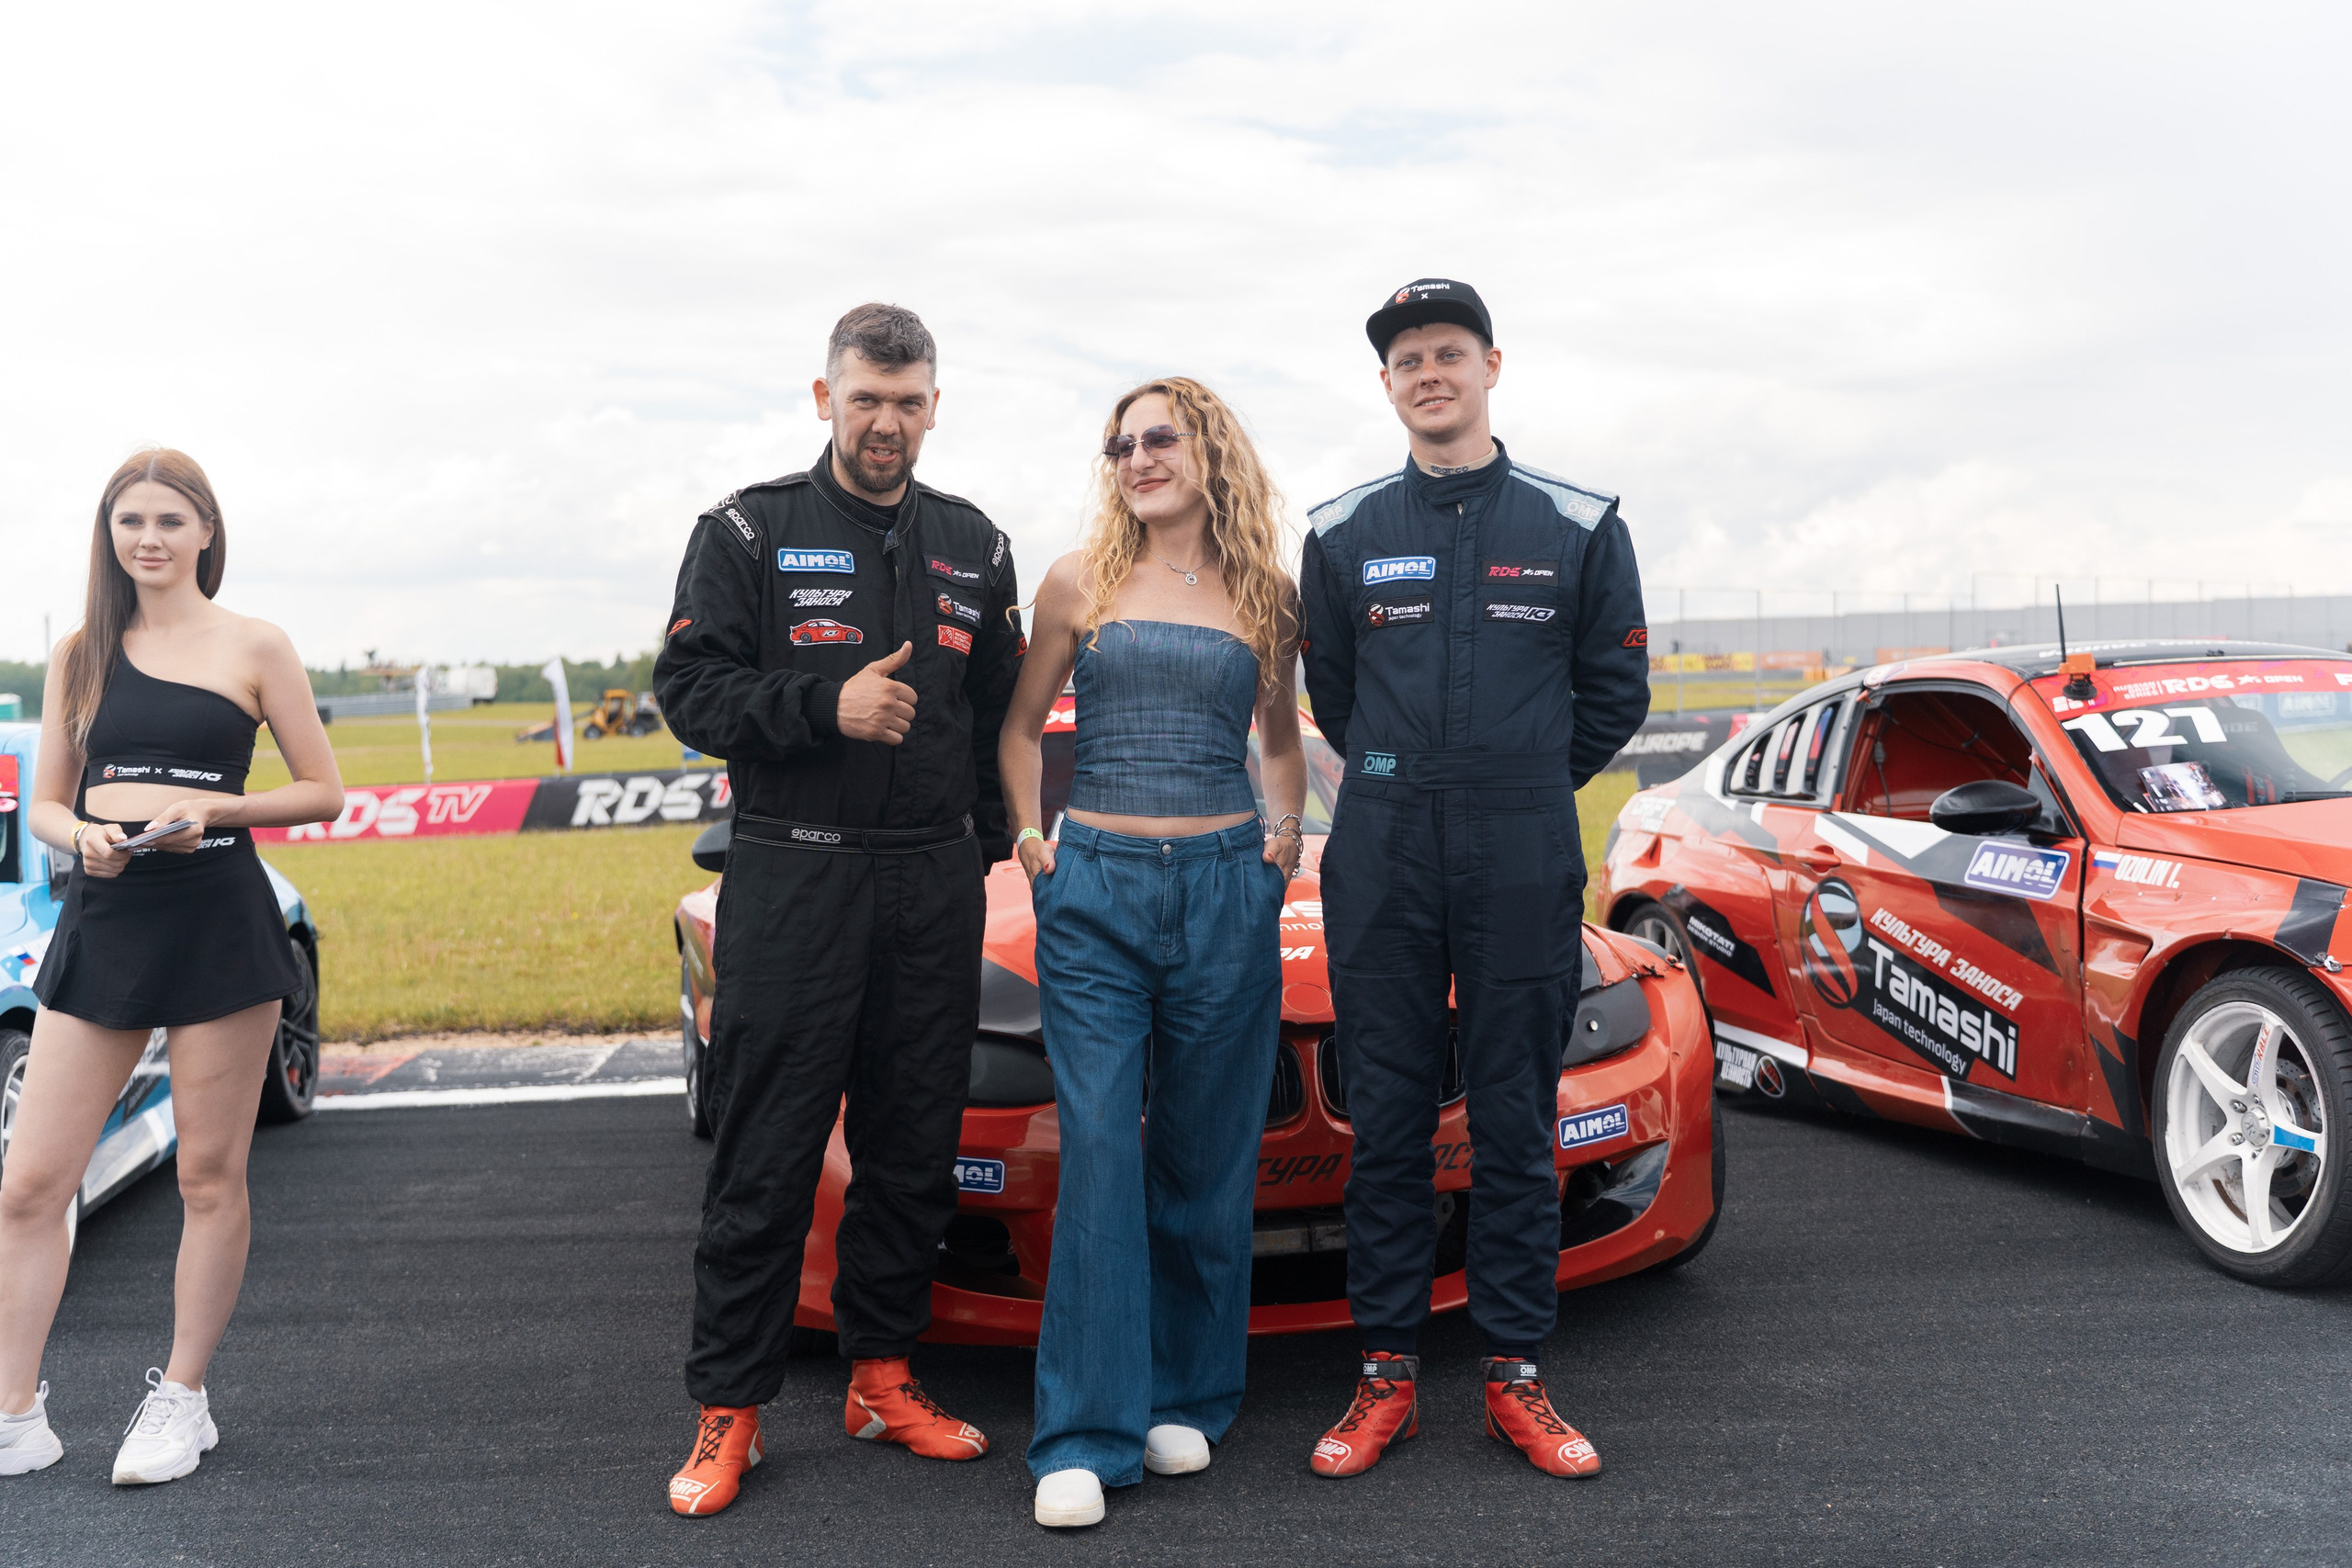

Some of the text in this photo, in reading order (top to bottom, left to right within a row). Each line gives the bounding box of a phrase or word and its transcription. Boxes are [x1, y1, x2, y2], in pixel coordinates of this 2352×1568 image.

[1411, 283, 1451, 293] Tamashi
[1430, 465, 1468, 474] sparco
[1315, 505, 1343, 526] OMP
[1566, 501, 1600, 518] OMP
[726, 508, 755, 541] sparco
[782, 554, 851, 569] AIMOL
[1366, 561, 1430, 581] AIMOL
[1488, 566, 1522, 577] RDS
[789, 589, 853, 599] КУЛЬТУРА
[794, 598, 844, 607] ЗАНОСА
[954, 601, 980, 619] Tamashi
[1385, 603, 1430, 615] Tamashi
[1487, 604, 1530, 613] КУЛЬТУРА
[1491, 611, 1525, 619] ЗАНОСА
[2161, 674, 2304, 694] RDS OPEN
[2062, 706, 2227, 752] 127
[117, 766, 151, 774] Tamashi
[1363, 755, 1396, 773] OMP
[426, 785, 493, 824] TV
[571, 773, 712, 826] RDS
[791, 829, 841, 843] sparco
[1970, 851, 2057, 889] AIMOL
[2114, 854, 2183, 888] OZOLIN I.
[1689, 916, 1736, 952] MIKOTATI
[1708, 939, 1734, 958] STUDIO
[1870, 907, 2024, 1011] КУЛЬТУРА ЗАНОСА
[1868, 936, 2017, 1077] Tamashi
[1873, 998, 1967, 1076] Japan technology
[1563, 1111, 1625, 1143] AIMOL
[1363, 1365, 1377, 1373] OMP
[1520, 1366, 1537, 1374] OMP
[1315, 1441, 1347, 1455] OMP
[669, 1480, 703, 1495] OMP
